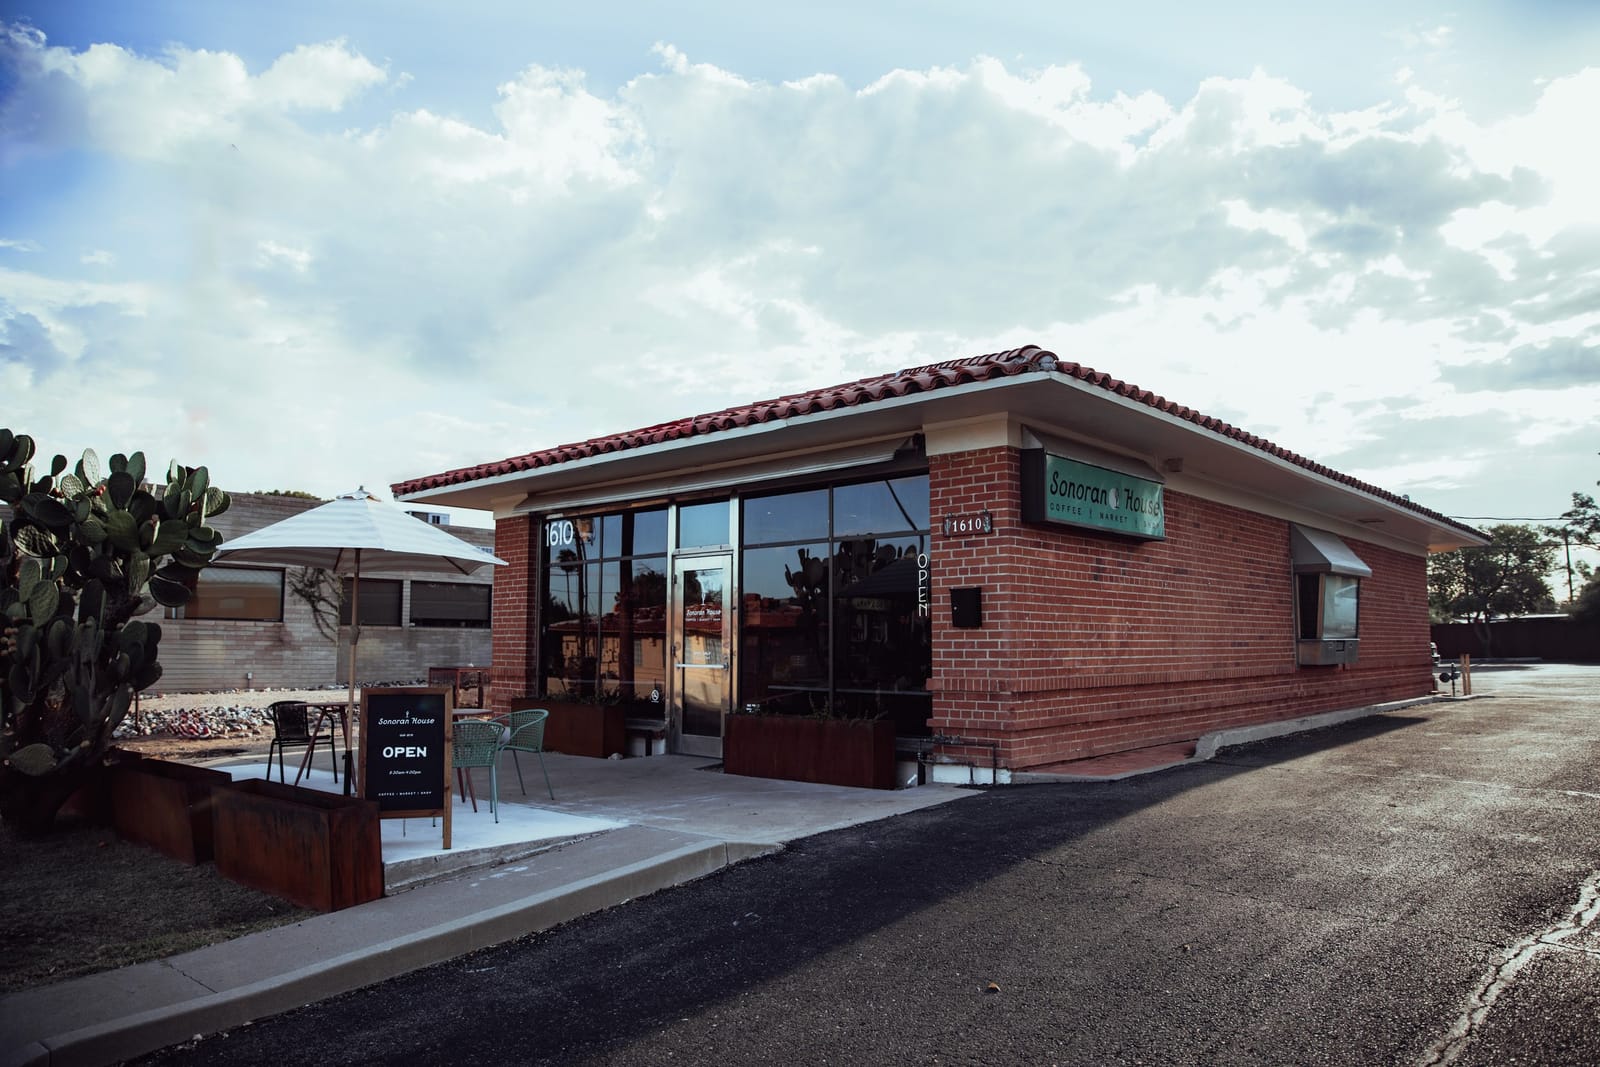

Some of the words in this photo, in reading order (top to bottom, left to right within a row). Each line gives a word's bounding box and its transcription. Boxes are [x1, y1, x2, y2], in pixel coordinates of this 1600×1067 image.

[1049, 471, 1108, 506] Sonoran
[1124, 488, 1161, 517] House
[1049, 502, 1082, 515] COFFEE
[1099, 512, 1128, 524] MARKET
[545, 521, 574, 547] 1610
[952, 518, 982, 532] 1610
[917, 553, 928, 617] OPEN
[378, 717, 410, 725] Sonoran
[411, 717, 435, 725] House
[382, 746, 427, 758] OPEN
